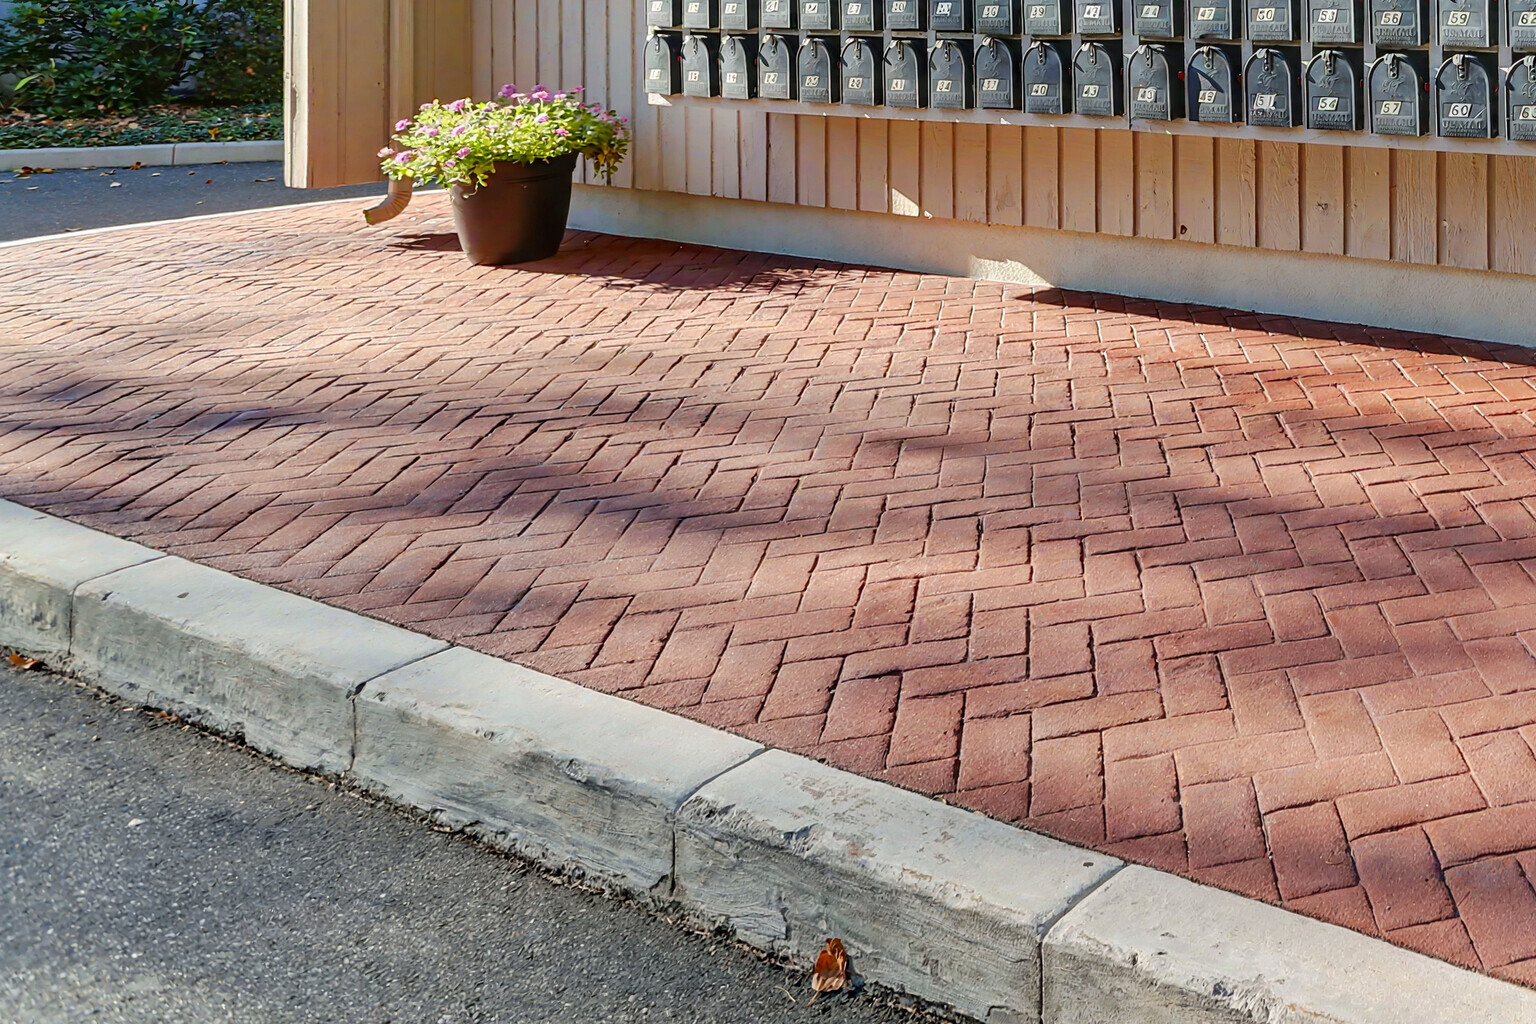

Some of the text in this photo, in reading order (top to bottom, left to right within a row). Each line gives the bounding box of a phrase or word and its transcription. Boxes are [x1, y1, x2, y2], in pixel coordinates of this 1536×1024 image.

[1383, 12, 1399, 24] 56
[1450, 12, 1468, 25] 59
[1382, 102, 1400, 113] 57
[1451, 104, 1469, 116] 60
